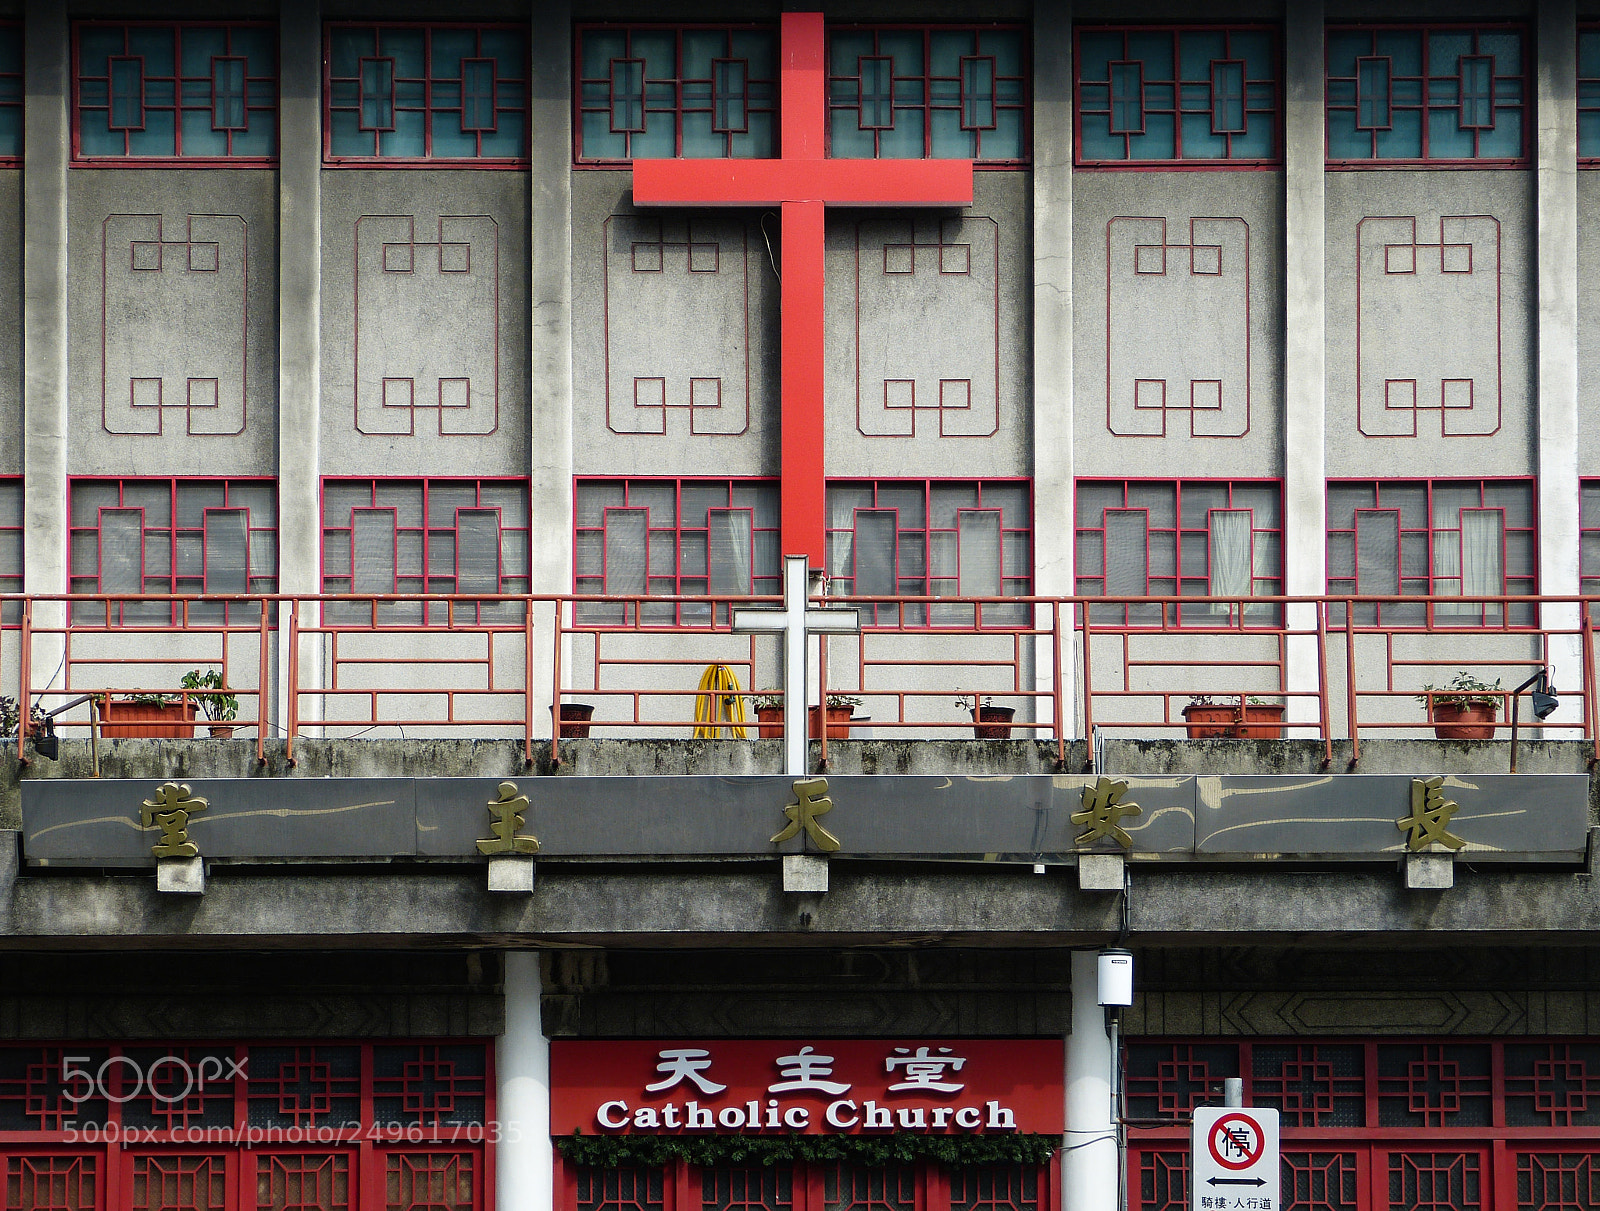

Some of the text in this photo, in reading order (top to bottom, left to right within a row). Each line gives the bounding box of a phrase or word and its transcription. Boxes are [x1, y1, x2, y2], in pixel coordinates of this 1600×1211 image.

[645, 1046, 966, 1095] 天主堂
[596, 1100, 1017, 1129] Catholic Church
[1222, 1127, 1250, 1157] 停
